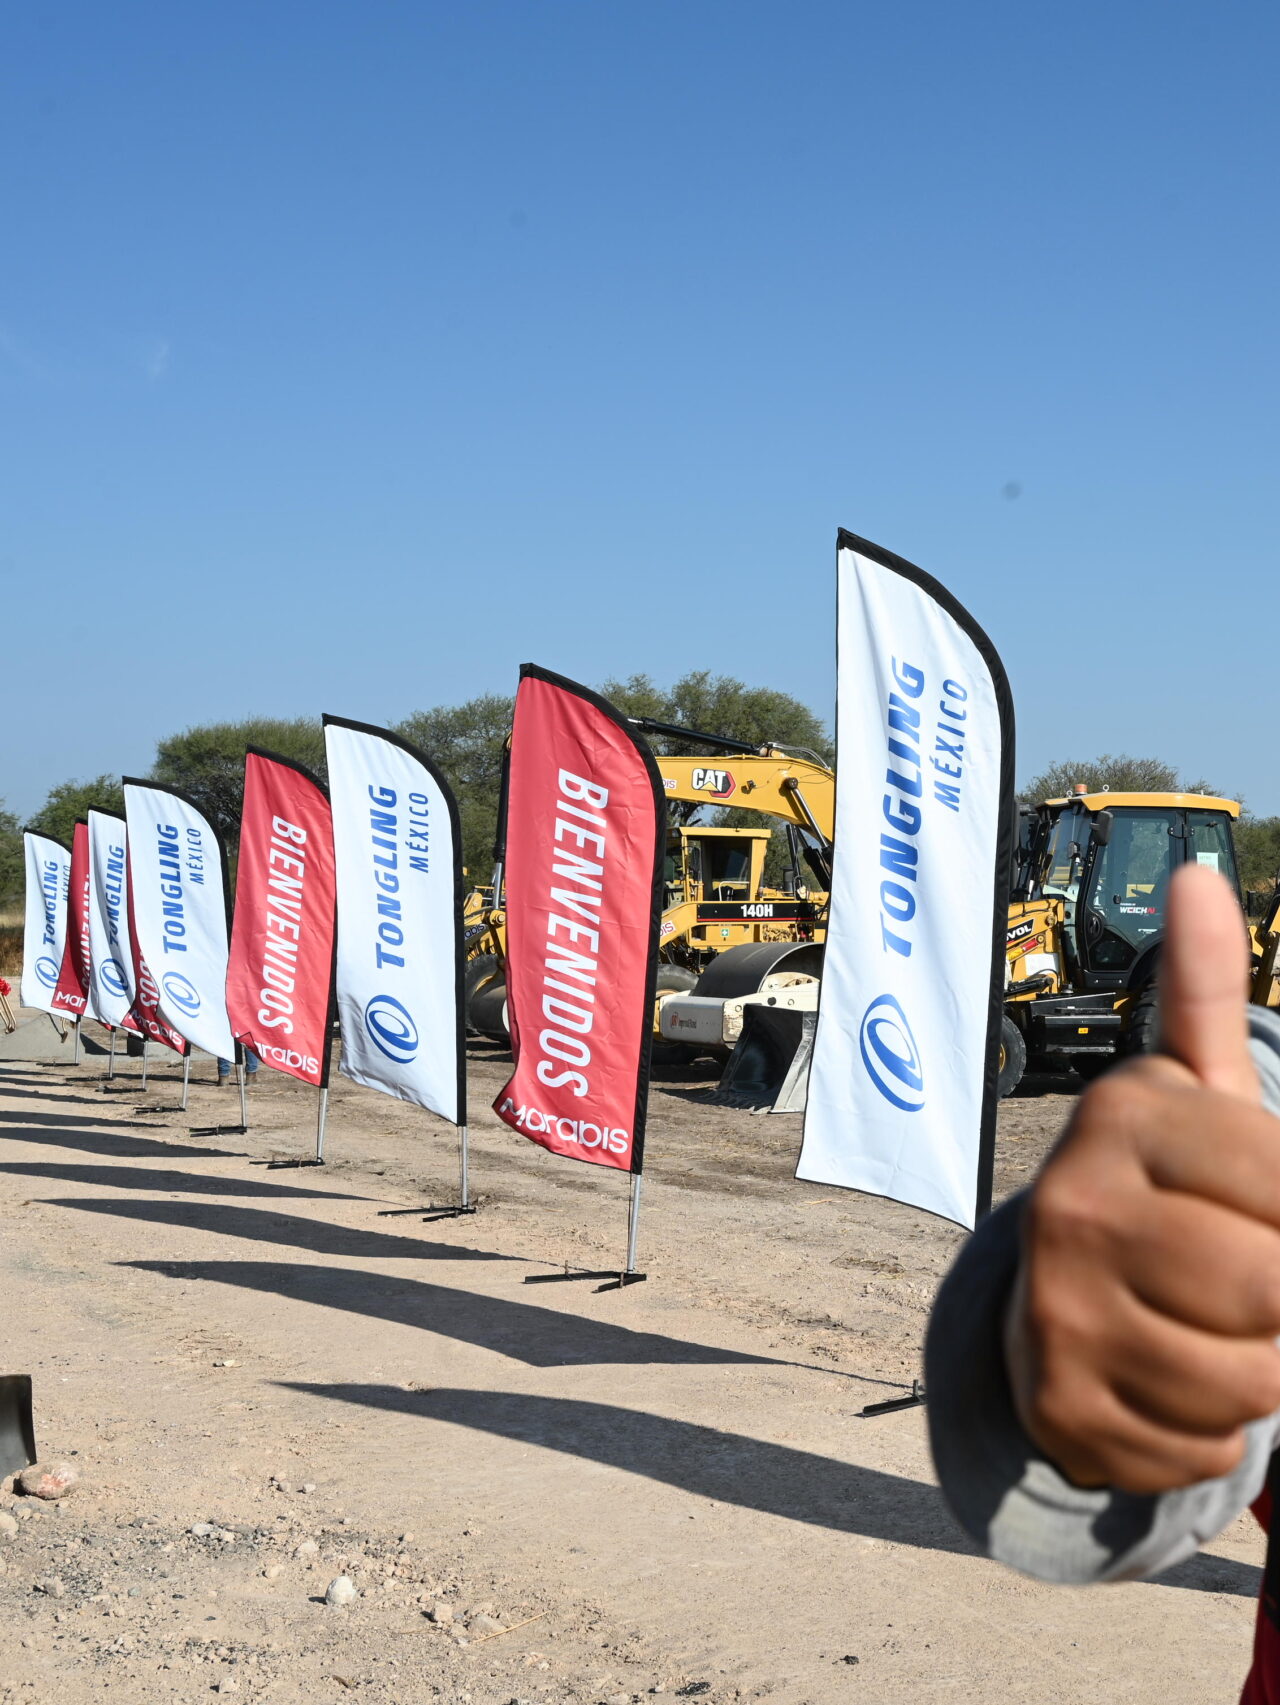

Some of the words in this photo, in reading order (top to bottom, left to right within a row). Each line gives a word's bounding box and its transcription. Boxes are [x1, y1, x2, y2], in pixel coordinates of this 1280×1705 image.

[692, 768, 727, 792] CAT
[930, 679, 968, 813] MÉXICO
[185, 827, 205, 885] MÉXICO
[404, 792, 429, 874] MÉXICO
[879, 655, 925, 958] TONGLING
[43, 860, 59, 946] TONGLING
[105, 844, 125, 946] TONGLING
[157, 823, 188, 954] TONGLING
[257, 815, 308, 1035] BIENVENIDOS
[368, 784, 405, 970] TONGLING
[740, 904, 774, 918] 140H
[536, 768, 609, 1098] BIENVENIDOS
[1006, 925, 1032, 942] VOL
